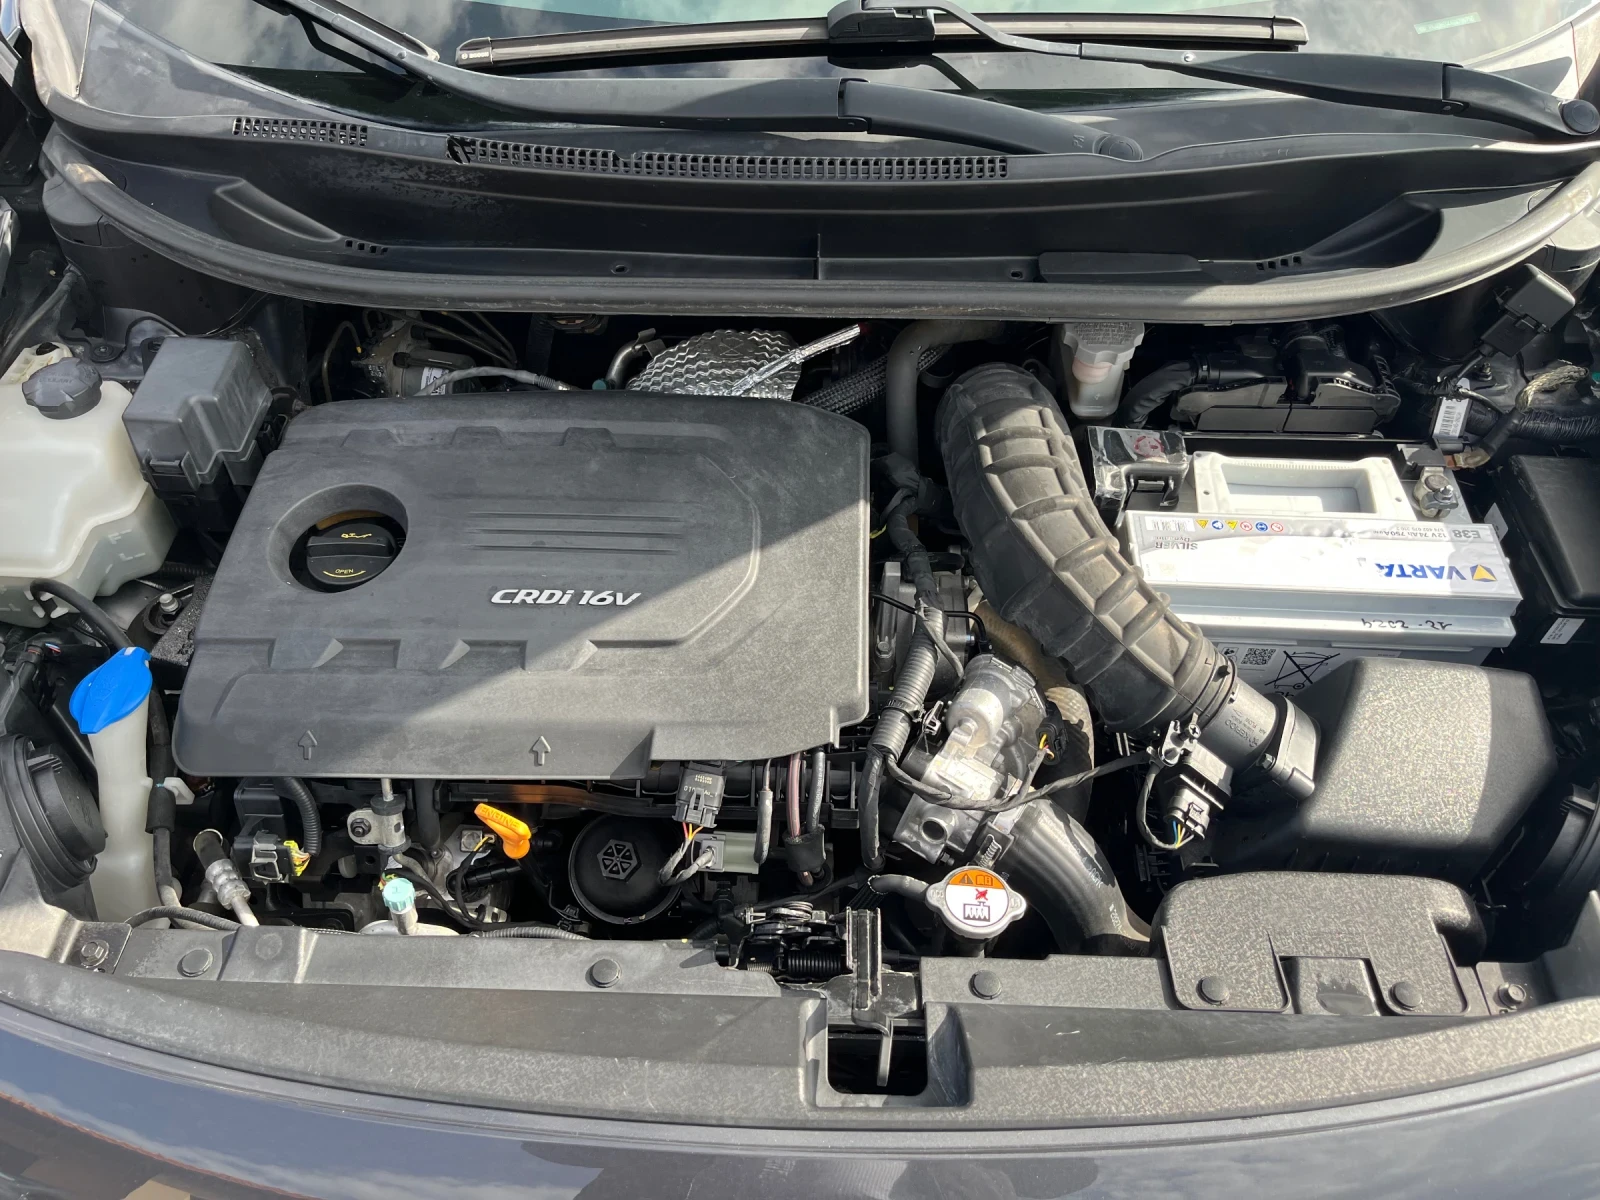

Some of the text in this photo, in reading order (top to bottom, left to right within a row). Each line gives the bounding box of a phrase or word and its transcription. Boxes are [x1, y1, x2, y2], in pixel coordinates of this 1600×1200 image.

[1452, 529, 1482, 539] E38
[1155, 541, 1199, 550] SILVER
[1375, 563, 1467, 580] VARTA
[490, 589, 642, 606] CRDi 16V
[480, 806, 520, 829] ENGINE
